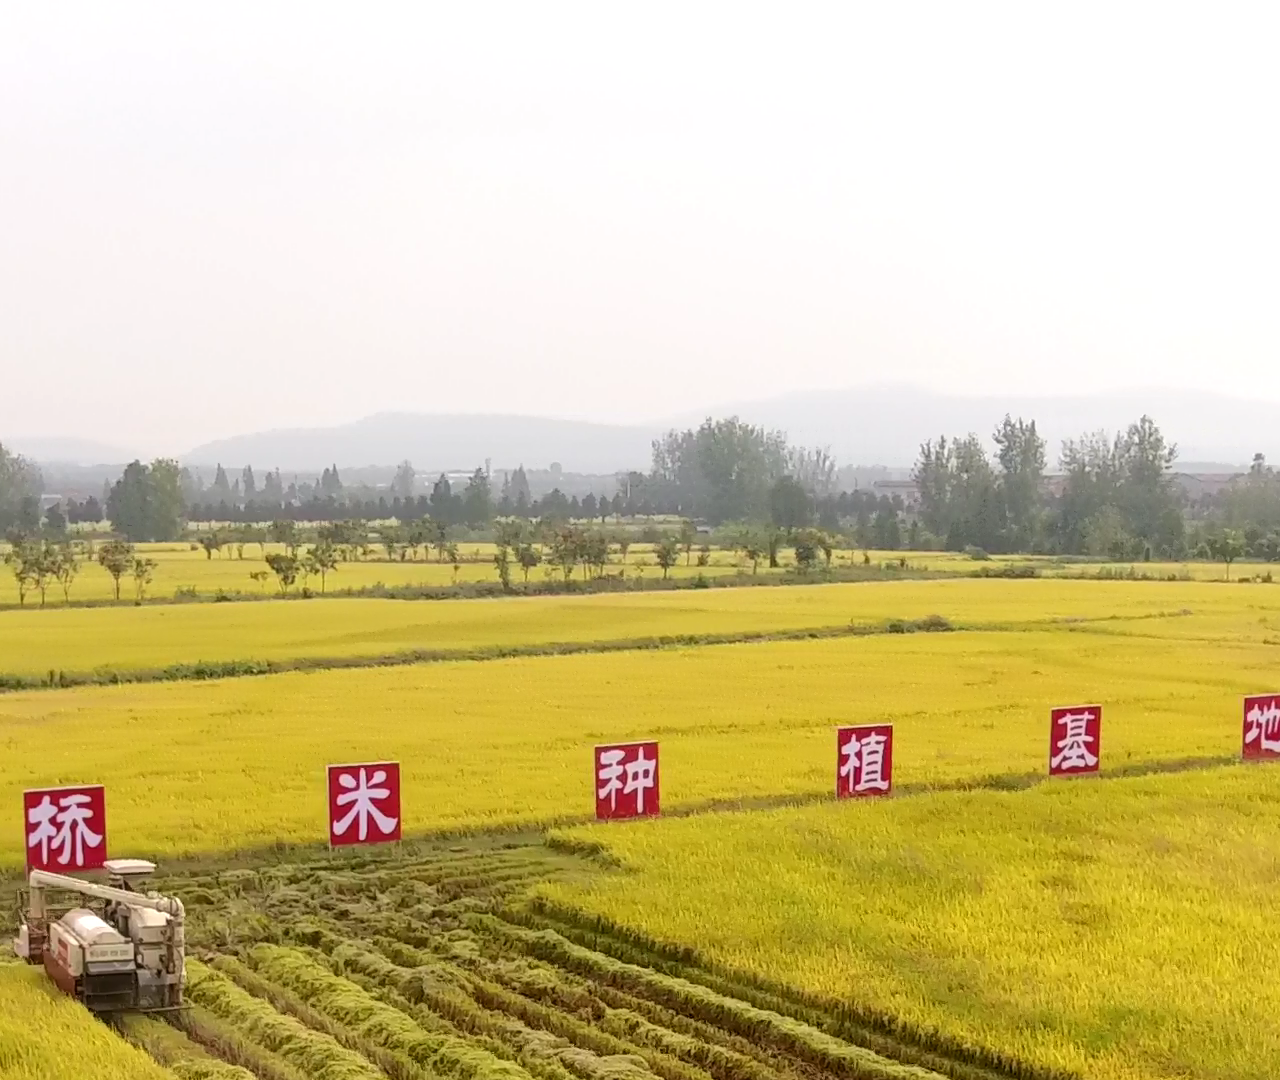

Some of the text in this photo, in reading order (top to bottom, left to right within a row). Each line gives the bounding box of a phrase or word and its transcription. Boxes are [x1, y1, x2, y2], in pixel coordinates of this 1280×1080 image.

[30, 794, 103, 866] 桥
[333, 767, 398, 840] 米
[598, 747, 657, 812] 种
[840, 731, 889, 793] 植
[1052, 711, 1098, 770] 基
